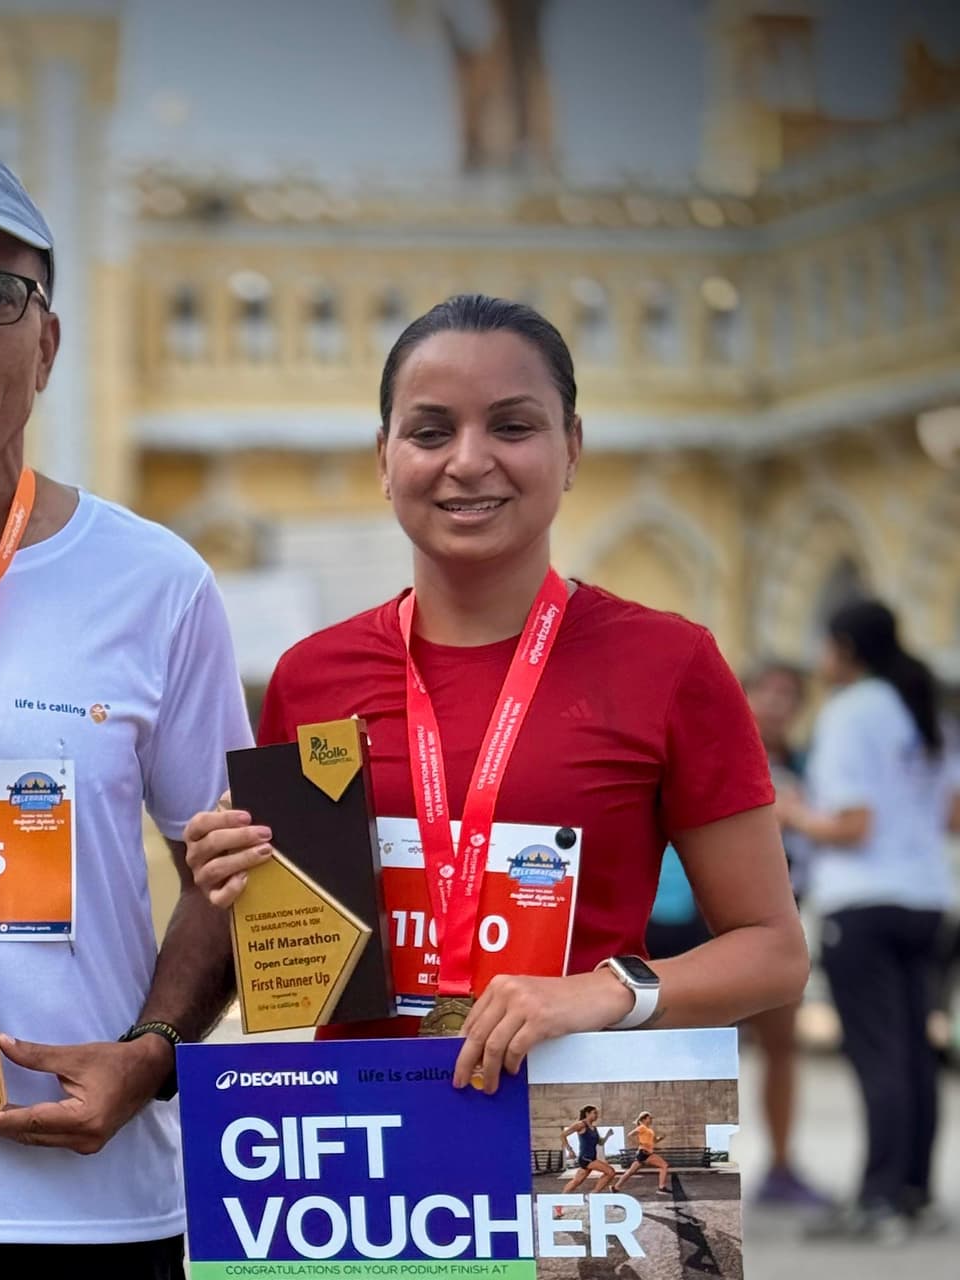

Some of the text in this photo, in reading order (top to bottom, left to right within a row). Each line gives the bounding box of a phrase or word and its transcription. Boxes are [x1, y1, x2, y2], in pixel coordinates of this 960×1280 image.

[15, 698, 86, 717] life is calling
[309, 747, 348, 764] Apollo
[491, 727, 514, 773] MARATHON
[476, 730, 502, 791] CELEBRATION
[420, 762, 436, 823] CELEBRATION
[245, 910, 293, 922] CELEBRATION
[261, 920, 301, 931] MARATHON
[248, 933, 340, 952] Half Marathon
[254, 954, 326, 971] Open Category
[251, 972, 330, 992] First Runner Up
[240, 1070, 338, 1087] DECATHLON
[358, 1067, 454, 1082] life is callin
[220, 1115, 402, 1181] GIFT
[222, 1193, 647, 1260] VOUCHER
[226, 1265, 508, 1275] CONGRATULATIONS ON YOUR PODIUM FINISH AT
